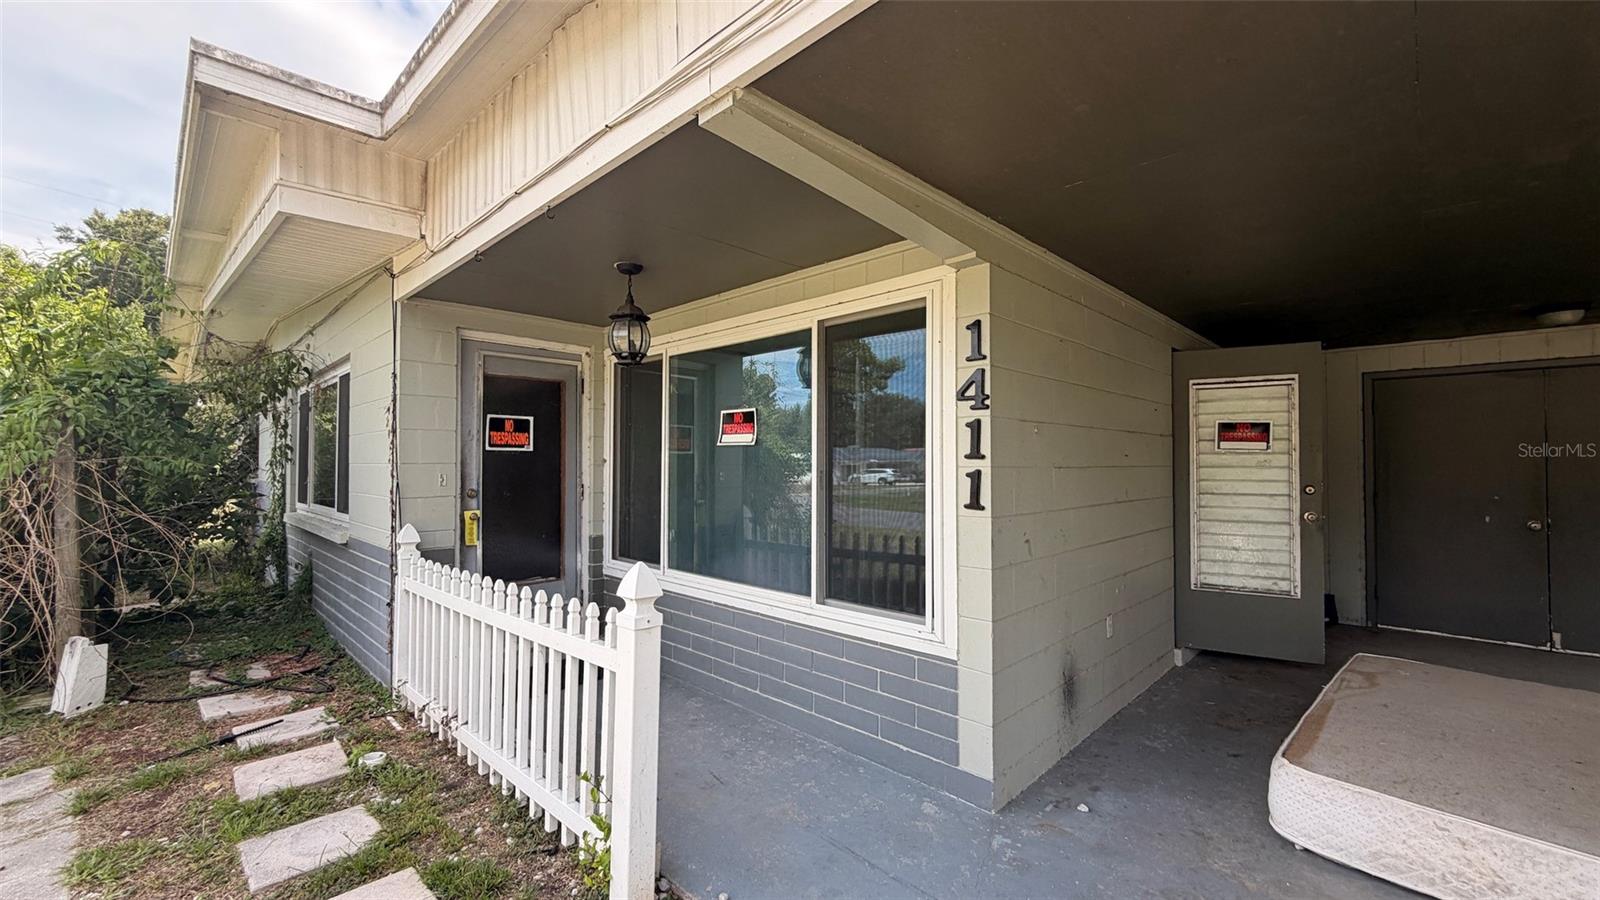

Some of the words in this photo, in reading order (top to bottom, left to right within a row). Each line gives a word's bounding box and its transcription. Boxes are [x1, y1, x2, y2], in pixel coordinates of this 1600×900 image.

[734, 412, 743, 424] NO
[956, 319, 990, 511] 1411
[505, 419, 514, 432] NO
[723, 423, 754, 434] TRESPASSING
[1236, 423, 1251, 433] NO
[490, 431, 529, 446] TRESPASSING
[1220, 432, 1268, 441] TRESPASSING
